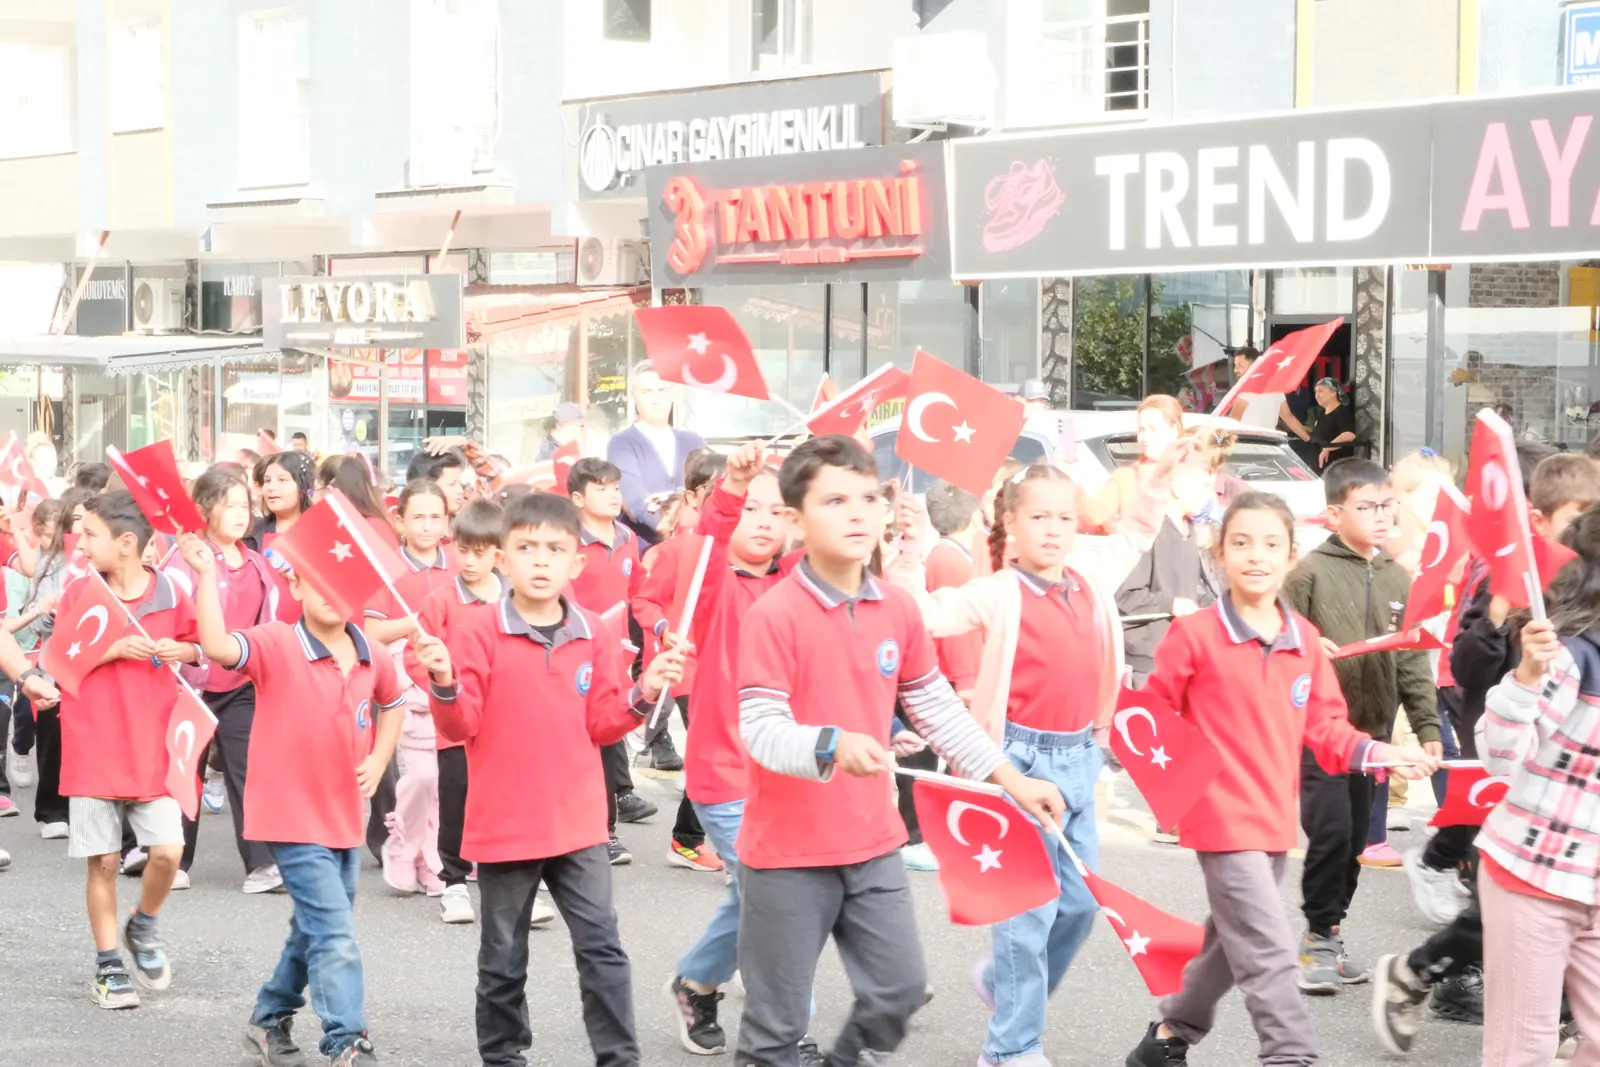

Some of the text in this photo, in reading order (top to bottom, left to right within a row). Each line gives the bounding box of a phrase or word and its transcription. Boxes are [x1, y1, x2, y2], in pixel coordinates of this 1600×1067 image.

[615, 103, 865, 187] ÇINAR GAYRİMENKUL
[1094, 114, 1600, 252] TREND AY
[709, 159, 921, 244] TANTUNİ
[223, 275, 256, 296] KAHVE
[279, 280, 434, 323] LEVORA
